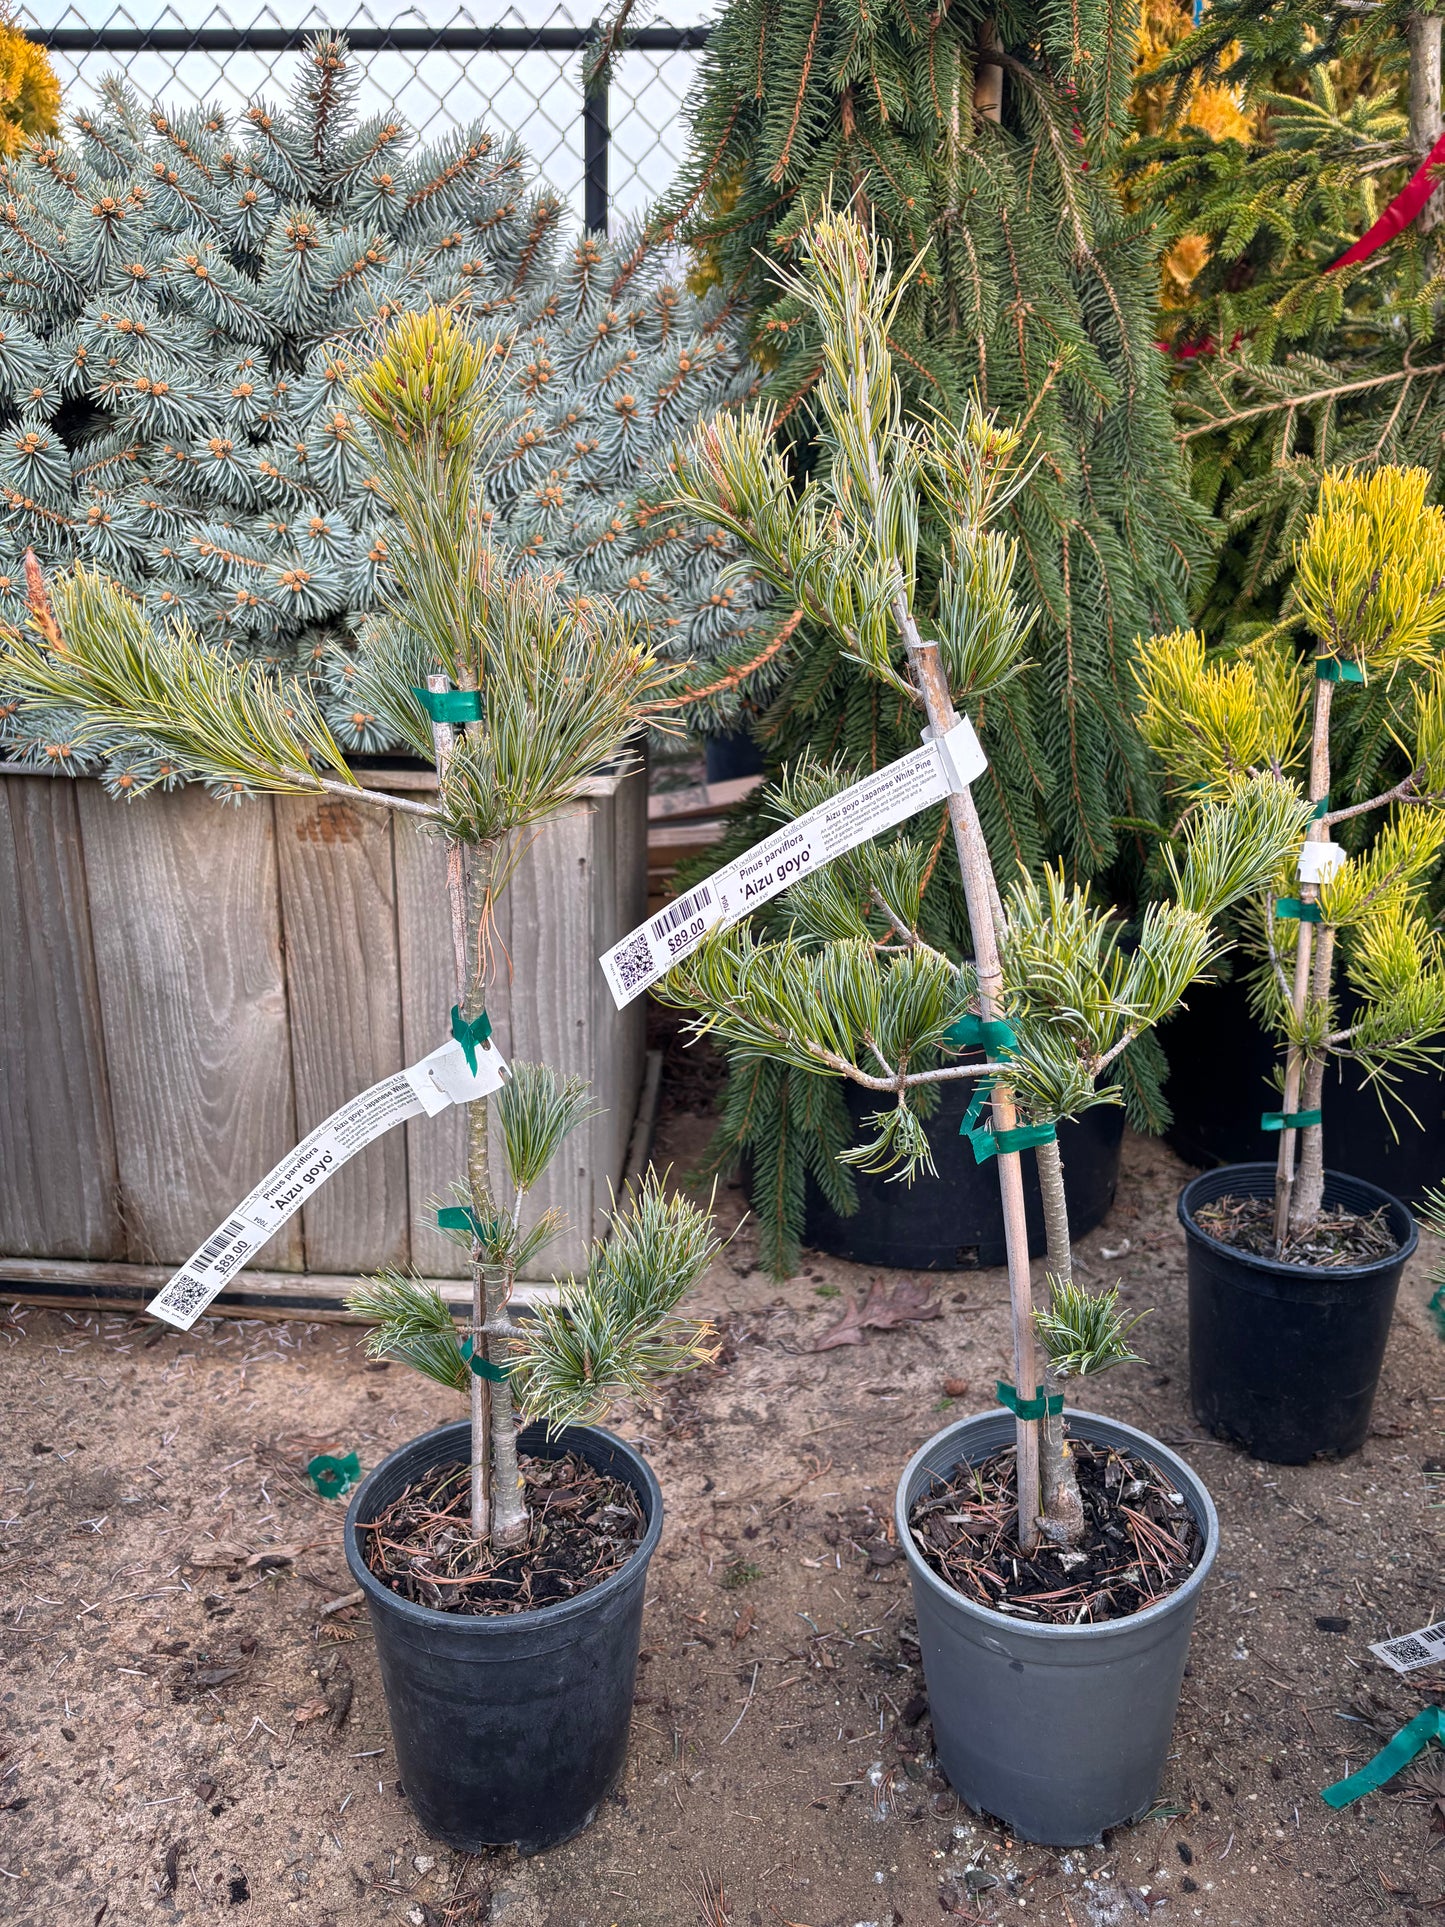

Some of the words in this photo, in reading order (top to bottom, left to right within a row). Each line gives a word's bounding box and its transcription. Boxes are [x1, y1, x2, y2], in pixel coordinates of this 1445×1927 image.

[824, 810, 842, 822] Aizu
[840, 798, 860, 816] goyo
[858, 778, 894, 804] Japanese
[892, 766, 915, 784] White
[913, 757, 932, 772] Pine
[835, 787, 859, 803] Carolina
[857, 774, 880, 791] Conifers
[879, 763, 901, 779] Nursery
[905, 745, 935, 764] Landscape
[738, 859, 764, 880] Pinus
[763, 832, 804, 866] parviflora
[738, 871, 775, 901] 'Aizu
[774, 842, 814, 882] goyo'
[720, 894, 730, 913] 7004
[666, 916, 704, 954] $89.00
[332, 1118, 349, 1132] Aizu
[347, 1108, 365, 1122] goyo
[362, 1089, 393, 1111] Japanese
[389, 1080, 410, 1094] White
[338, 1100, 358, 1117] Carolina
[356, 1088, 377, 1104] Conifers
[262, 1178, 286, 1201] Pinus
[283, 1146, 319, 1182] parviflora
[269, 1181, 304, 1213] 'Aizu
[301, 1149, 335, 1186] goyo'
[252, 1215, 268, 1227] 7004
[213, 1239, 248, 1275] $89.00
